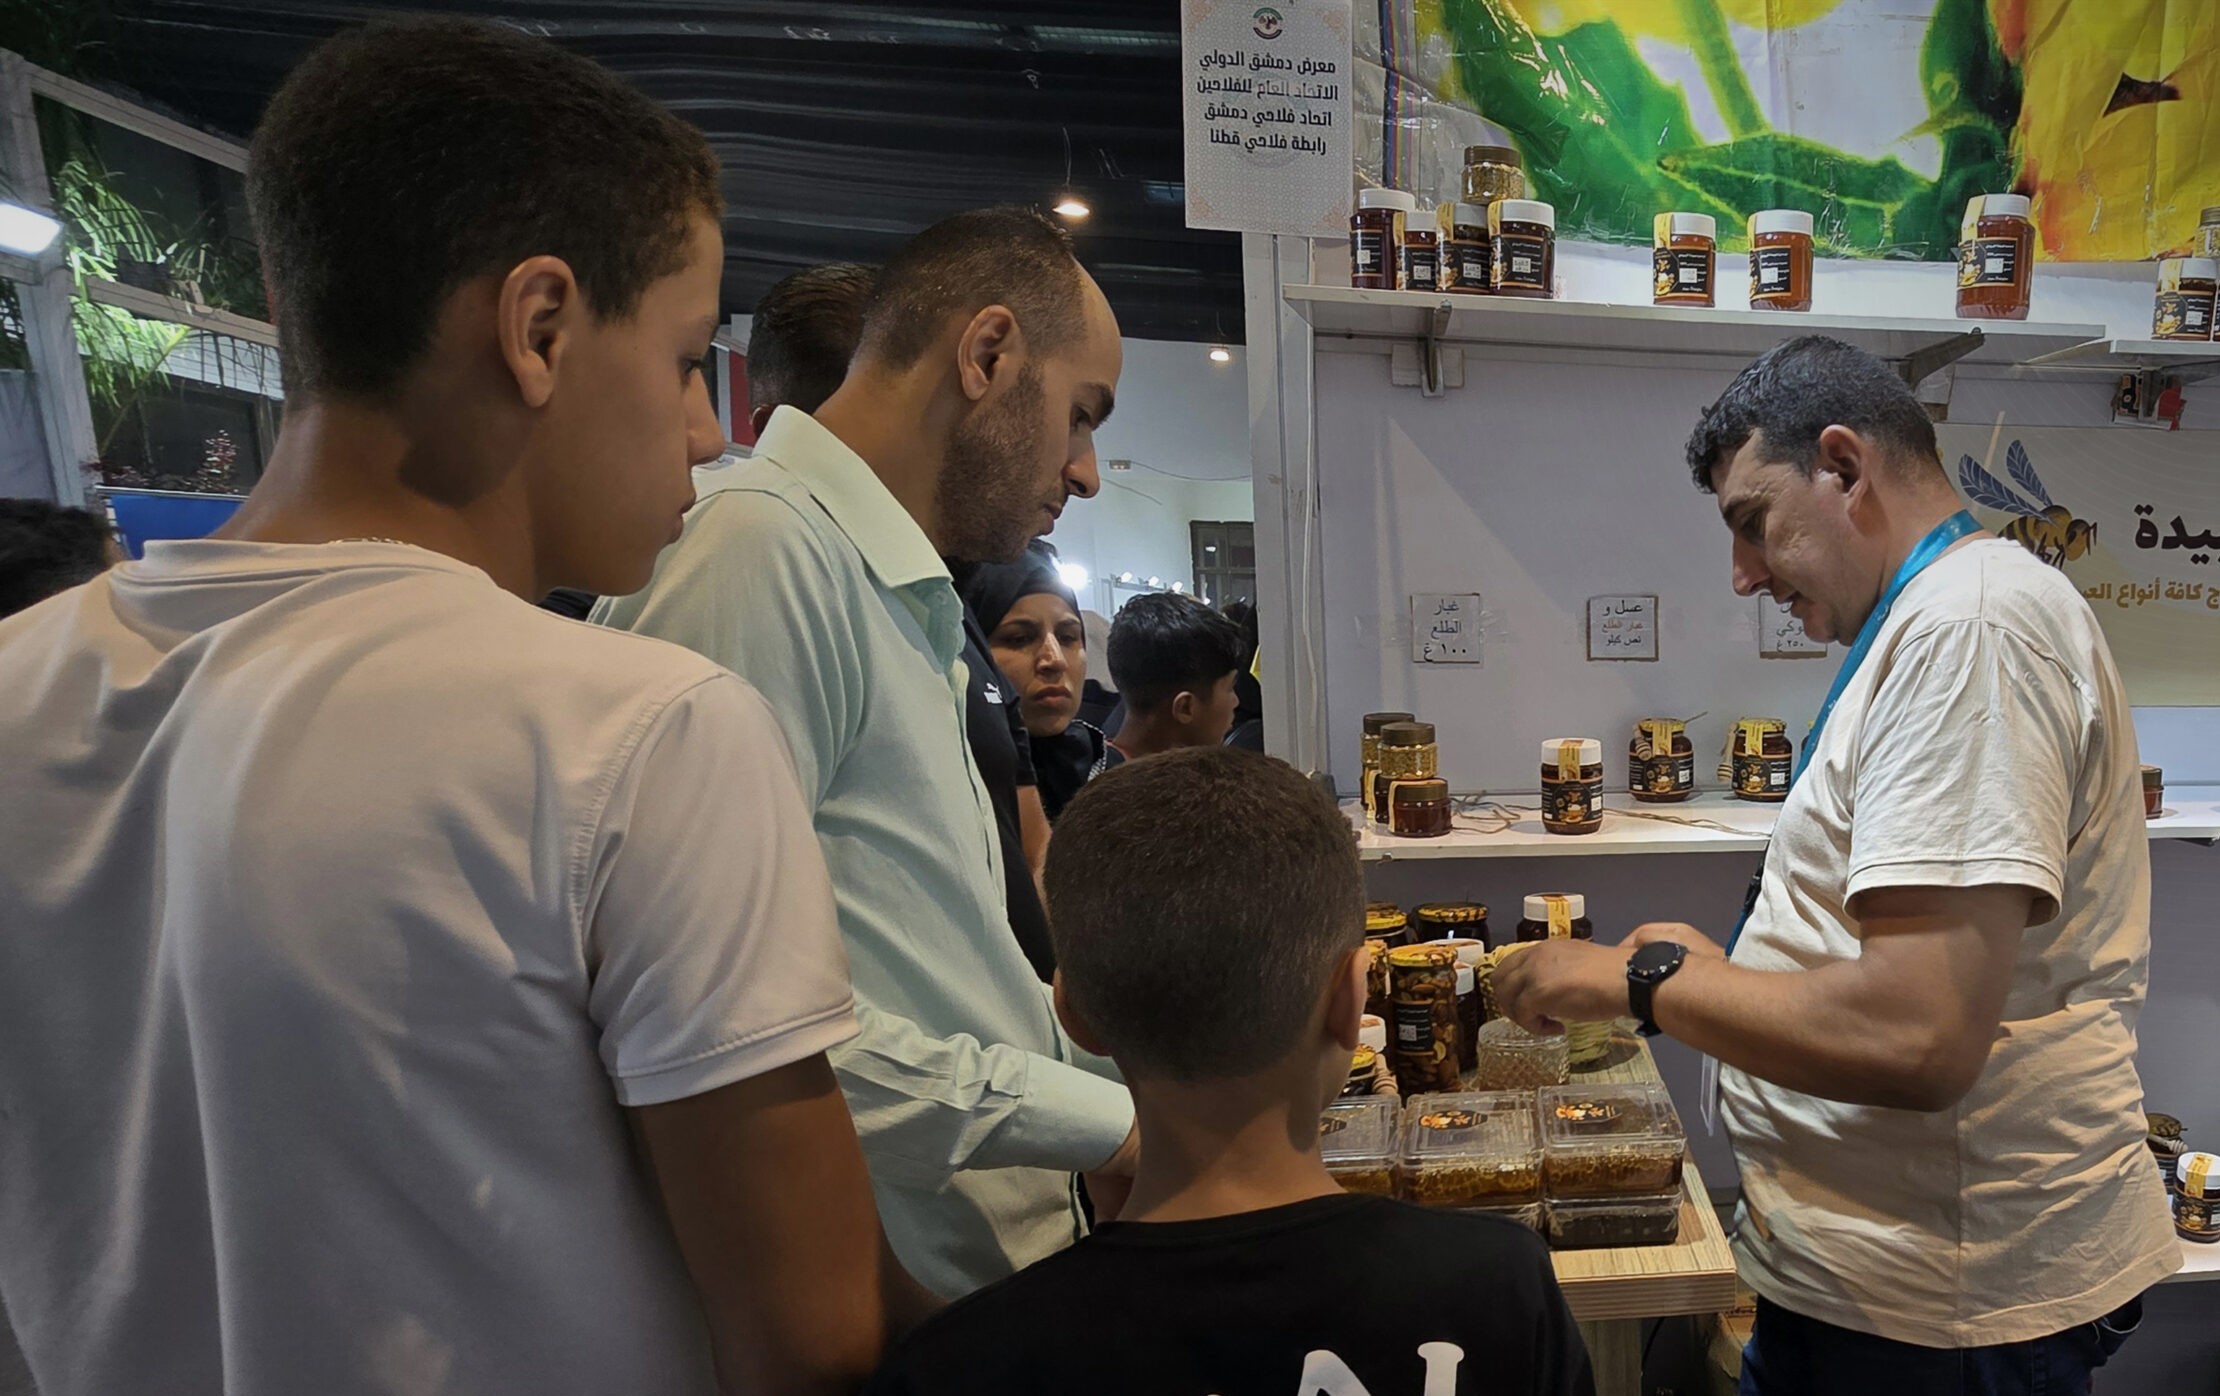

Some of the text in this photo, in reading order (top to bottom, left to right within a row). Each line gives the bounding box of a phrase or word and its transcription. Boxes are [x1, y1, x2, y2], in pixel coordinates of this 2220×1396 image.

[1199, 49, 1336, 76] معرض دمشق الدولي
[1197, 76, 1339, 101] الاتحاد العام للفلاحين
[1204, 102, 1332, 128] اتحاد فلاحي دمشق
[1210, 128, 1327, 156] رابطة فلاحي قطنا
[2116, 577, 2161, 608] أنواع
[2164, 581, 2203, 601] كافة
[1433, 598, 1460, 615] غبار
[1602, 599, 1643, 617] عسل و
[1430, 619, 1462, 640] الطلع
[1776, 620, 1804, 637] وكي
[1605, 634, 1642, 647] نص كيلو
